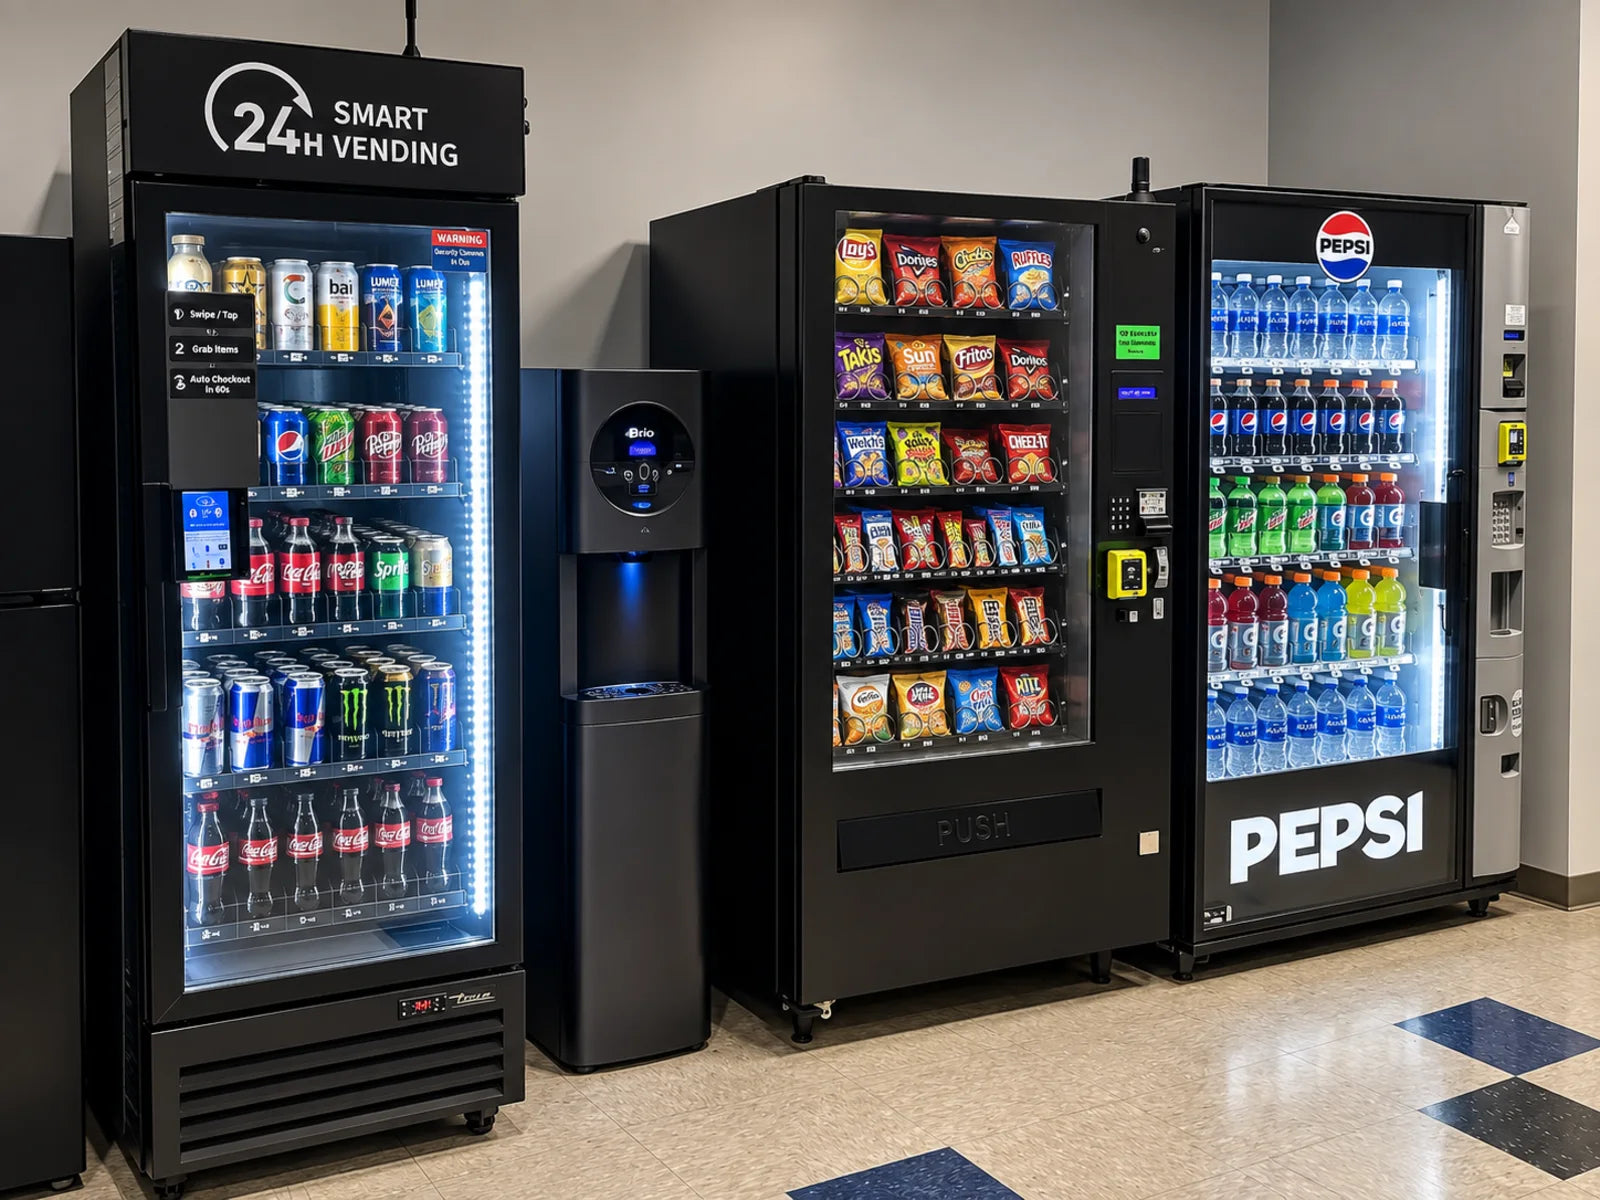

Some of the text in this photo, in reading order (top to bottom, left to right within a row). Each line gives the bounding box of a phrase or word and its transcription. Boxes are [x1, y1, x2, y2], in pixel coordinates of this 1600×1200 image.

[333, 101, 428, 131] SMART
[332, 134, 458, 167] VENDING
[436, 233, 483, 245] WARNING
[1320, 238, 1370, 255] PEPSI
[1011, 250, 1052, 270] RUFFLES
[329, 279, 353, 295] bai
[190, 309, 216, 320] Swipe
[175, 342, 239, 354] 2 Grab Items
[903, 348, 936, 364] Sun
[958, 348, 993, 369] Fritos
[190, 375, 211, 383] Auto
[215, 385, 230, 394] 60s
[628, 427, 655, 438] Brio
[937, 811, 1011, 846] PUSH
[1229, 790, 1424, 885] PEPSI
